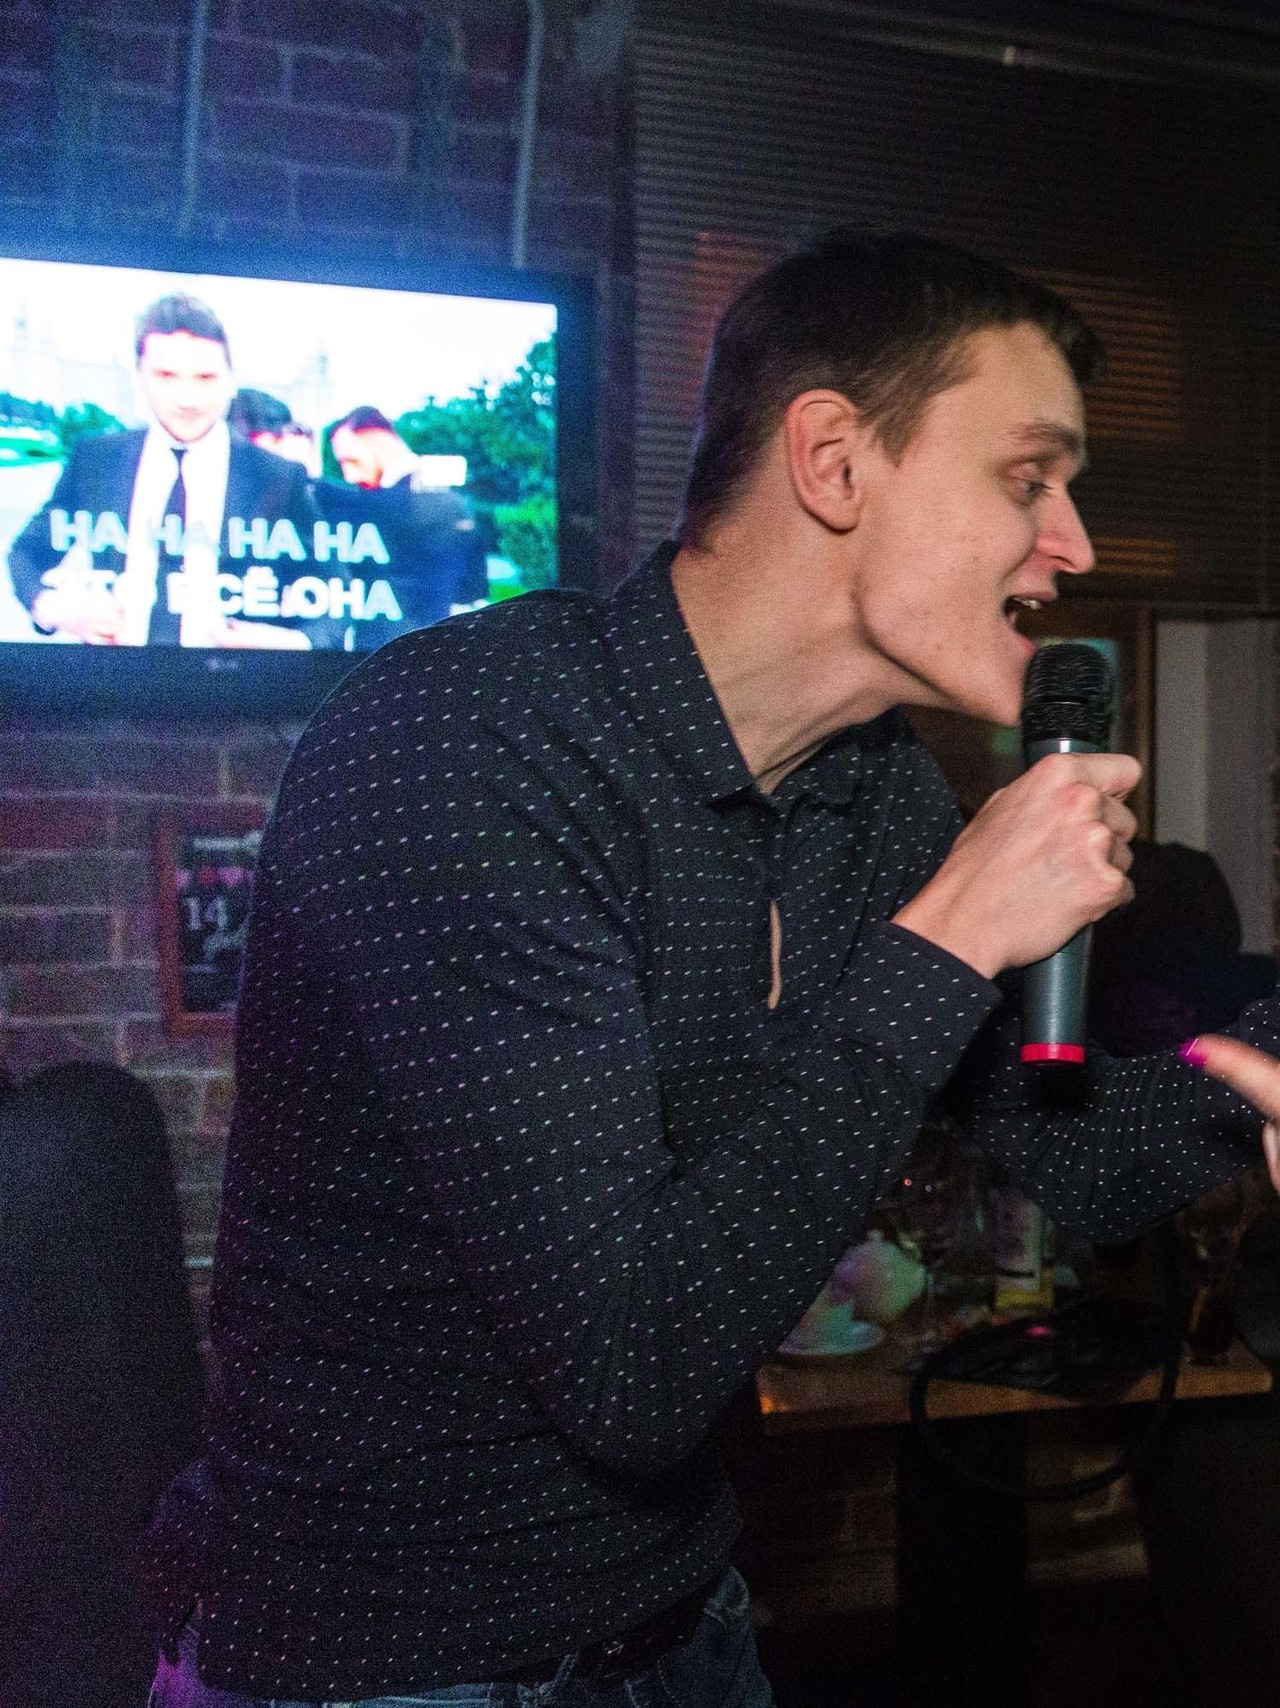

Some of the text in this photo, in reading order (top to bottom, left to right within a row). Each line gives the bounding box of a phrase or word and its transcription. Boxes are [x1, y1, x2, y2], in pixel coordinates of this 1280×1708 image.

[50, 509, 128, 554] НА
[228, 516, 307, 562] НА
[313, 520, 391, 565] НА
[289, 575, 403, 621] ОНА
